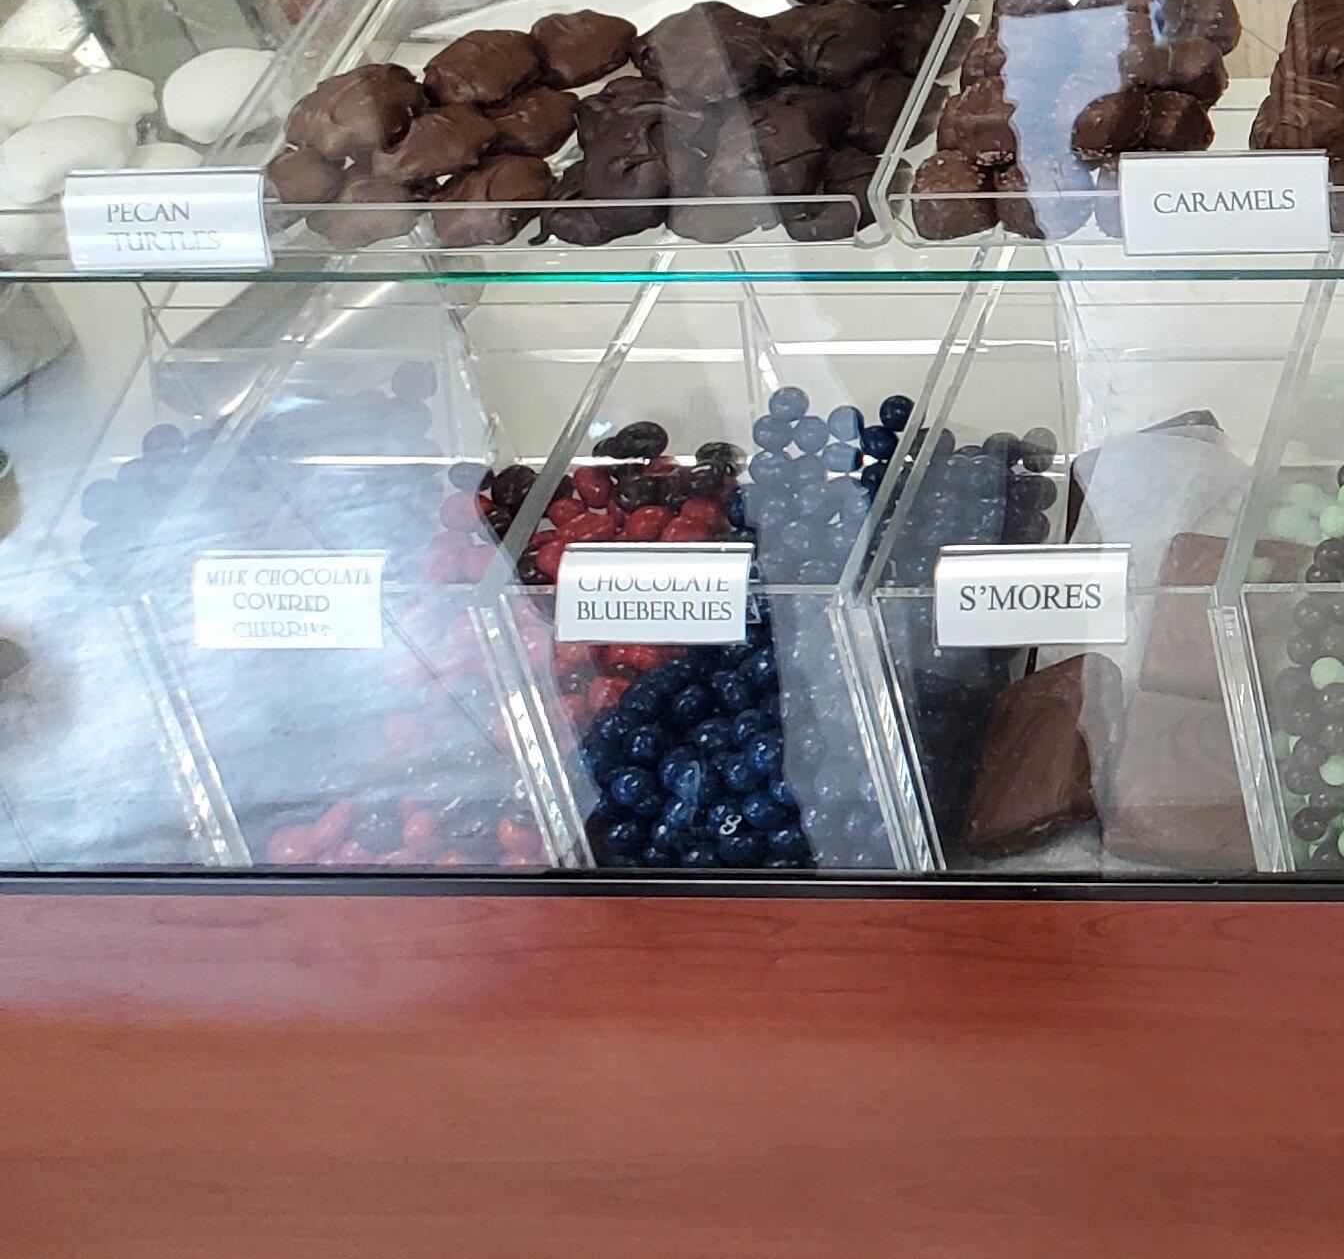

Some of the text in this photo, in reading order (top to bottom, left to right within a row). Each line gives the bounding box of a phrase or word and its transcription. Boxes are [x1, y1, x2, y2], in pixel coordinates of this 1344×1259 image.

[106, 202, 190, 223] PECAN
[1154, 190, 1296, 214] CARAMELS
[107, 231, 221, 252] TURTLES
[578, 576, 729, 594] CHOCOLATE
[233, 593, 330, 612] COVERED
[959, 584, 1102, 613] S'MORES
[577, 599, 732, 622] BLUEBERRIES
